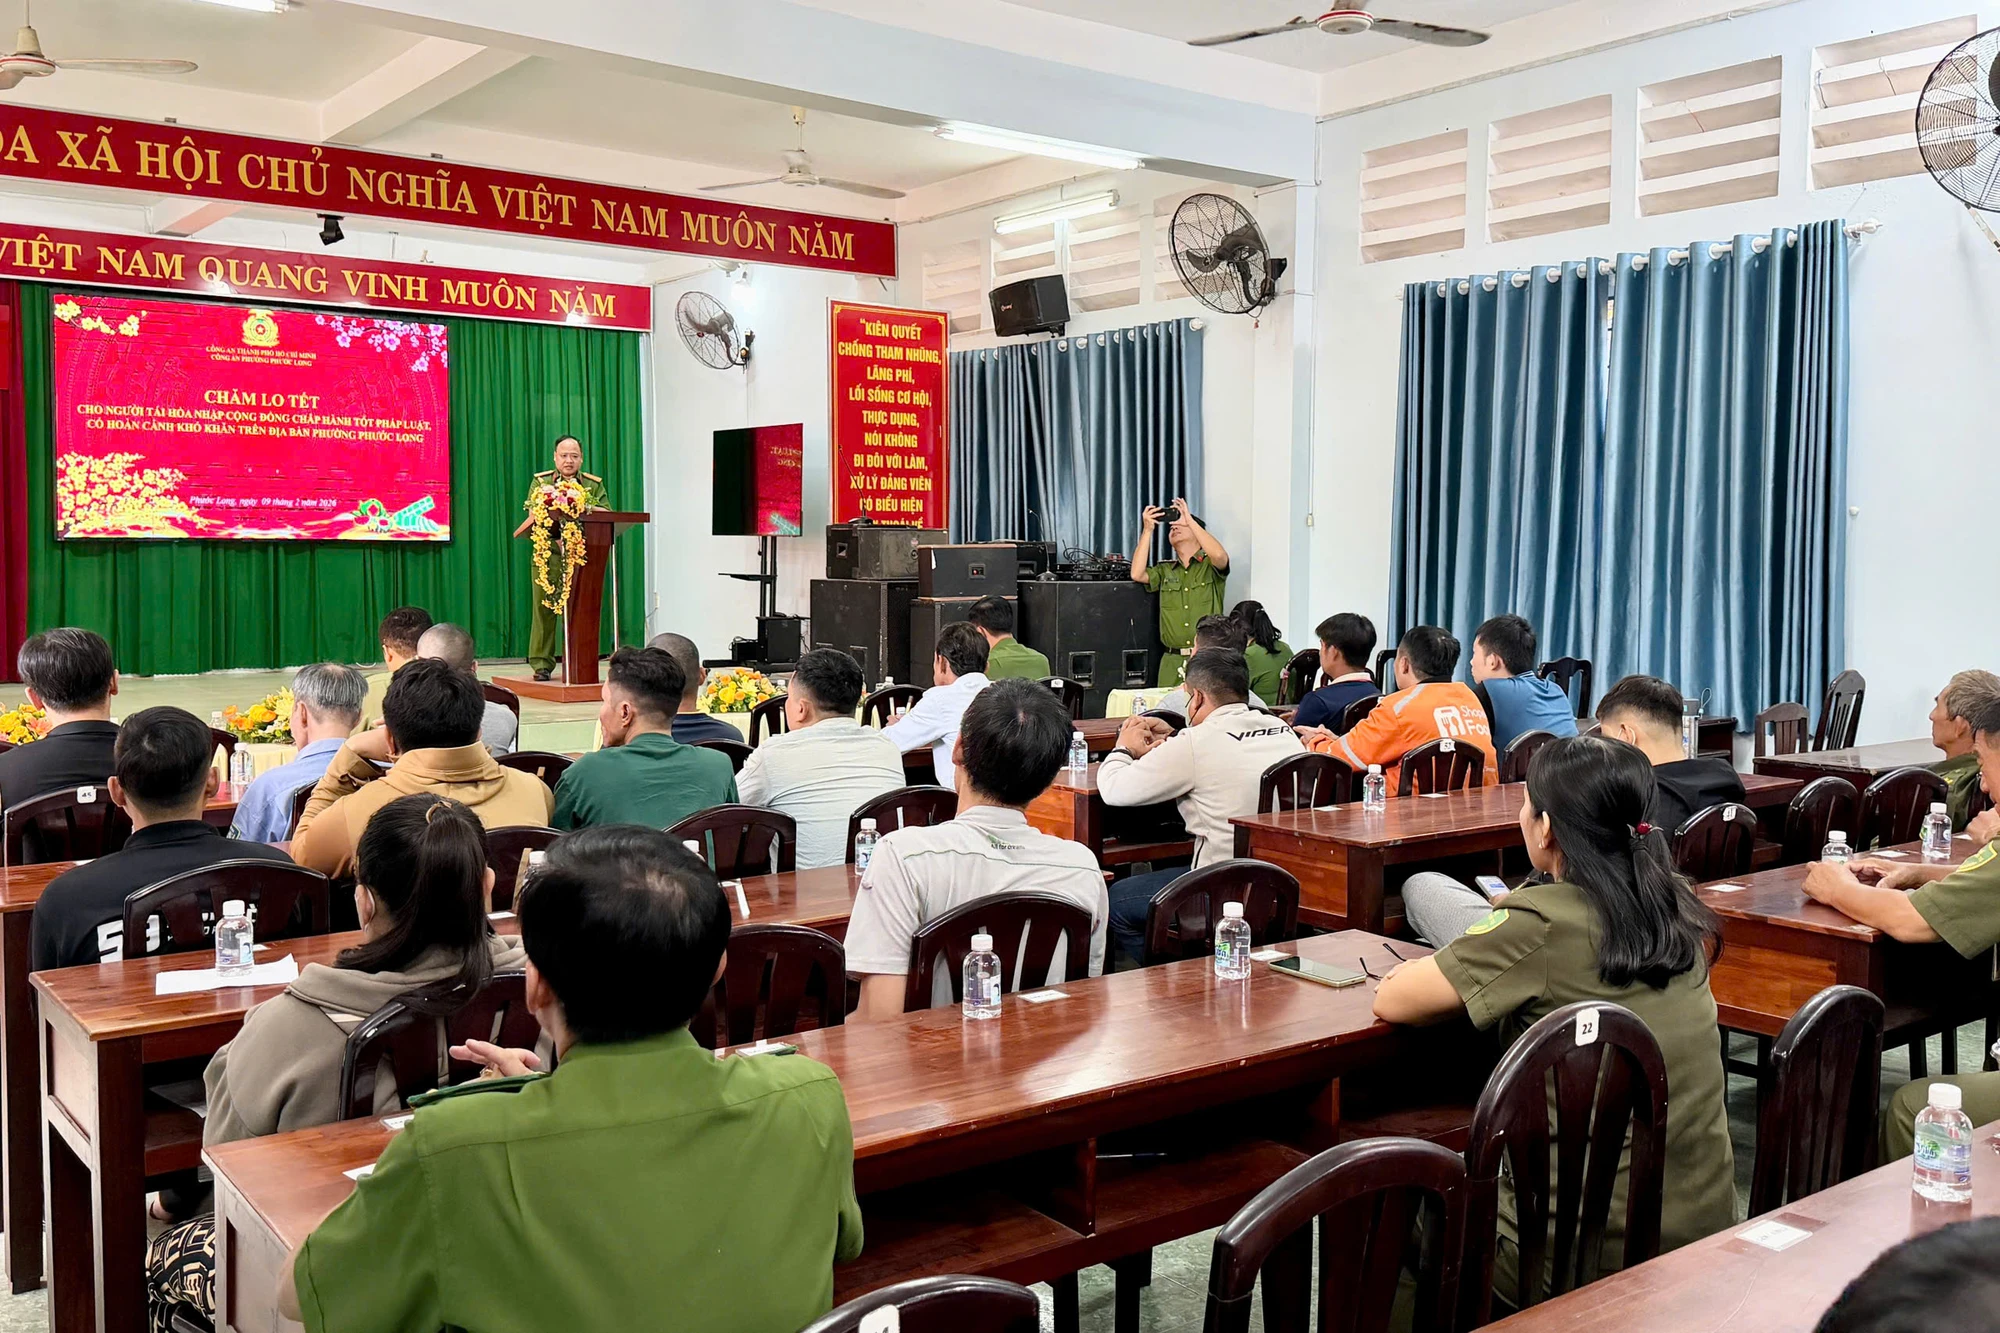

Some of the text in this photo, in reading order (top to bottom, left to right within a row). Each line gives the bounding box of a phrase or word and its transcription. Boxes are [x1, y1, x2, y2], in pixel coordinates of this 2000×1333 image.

[0, 126, 855, 261] A XÃ HỘI CHỦ NGHĨA VIỆT NAM MUÔN NĂM
[0, 233, 616, 318] VIỆT NAM QUANG VINH MUÔN NĂM
[891, 323, 922, 340] QUYẾT
[837, 339, 942, 365] CHỐNG THAM NHŨNG,
[867, 365, 915, 385] LÃNG PHÍ,
[204, 388, 320, 409] CHĂM LO TẾT
[849, 384, 932, 408] LỐI SỐNG CƠ HỘI,
[77, 404, 104, 414] CHO
[106, 405, 144, 417] NGƯỜI
[146, 406, 166, 418] TÁI
[168, 408, 193, 419] HÒA
[194, 410, 224, 422] NHẬP
[226, 411, 257, 422] CỘNG
[322, 415, 352, 427] HÀNH
[376, 418, 403, 429] PHÁP
[862, 411, 920, 428] THỰC DỤNG,
[87, 418, 424, 444] CÓ HOÀN CẢNH KHÓ KHĂN TRÊN ĐỊA BÀN PHƯỜNG PHƯỚC LONG
[864, 431, 918, 448] NÓI KHÔNG
[853, 452, 928, 471] ĐI ĐÔI VỚI LÀM,
[850, 472, 932, 491] XỬ LÝ ĐẢNG VIÊN
[319, 498, 337, 507] 2026
[875, 494, 898, 512] BIỂU
[900, 497, 923, 515] HIỆN
[1226, 725, 1293, 742] VIPER
[1582, 1022, 1593, 1035] 22
